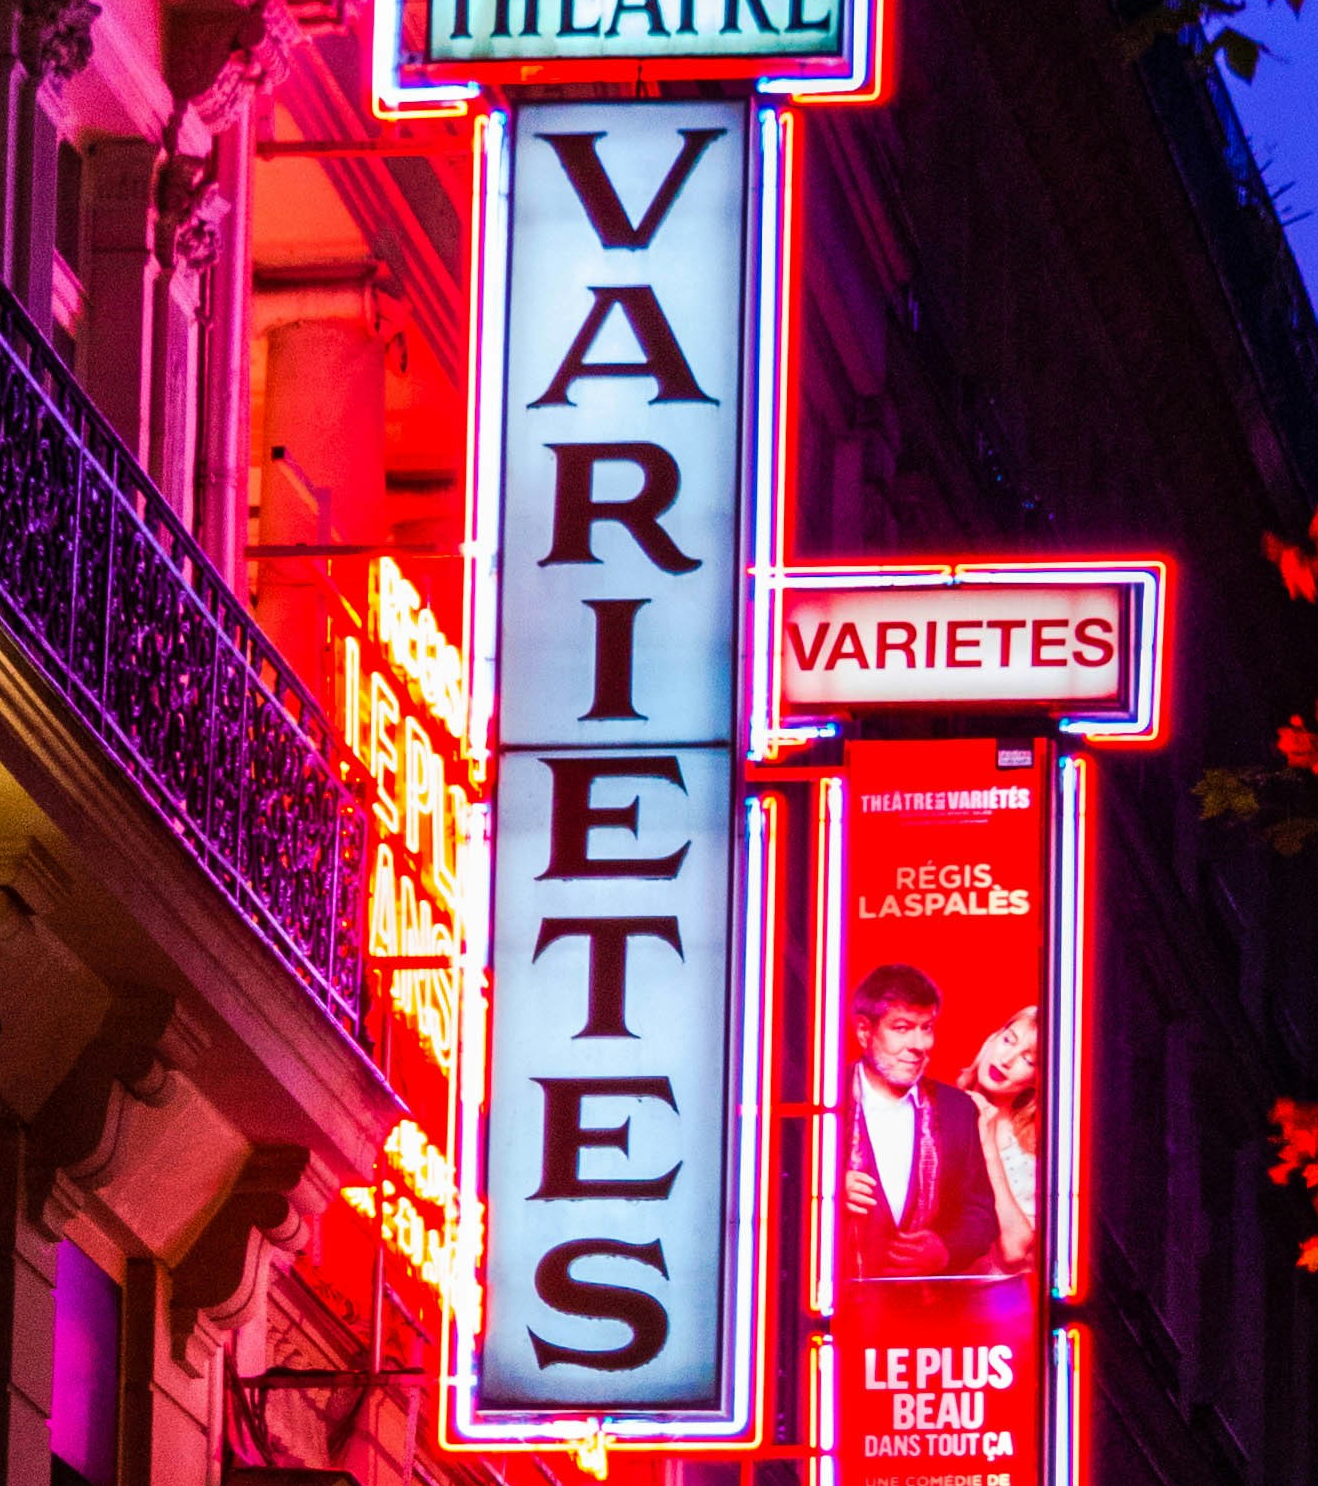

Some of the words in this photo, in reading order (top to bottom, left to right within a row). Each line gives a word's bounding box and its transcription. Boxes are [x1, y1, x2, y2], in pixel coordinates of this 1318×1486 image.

[790, 616, 1115, 674] VARIETES
[526, 127, 728, 1374] VARIETES
[946, 785, 1031, 811] VARIÉTÉS
[896, 858, 994, 891] RÉGIS
[858, 884, 1031, 920] LASPALÈS
[864, 1348, 911, 1391] LE
[917, 1344, 1014, 1390] PLUS
[892, 1391, 985, 1431] BEAU
[864, 1434, 922, 1458] DANS
[926, 1432, 980, 1458] TOUT
[982, 1431, 1014, 1461] ÇA
